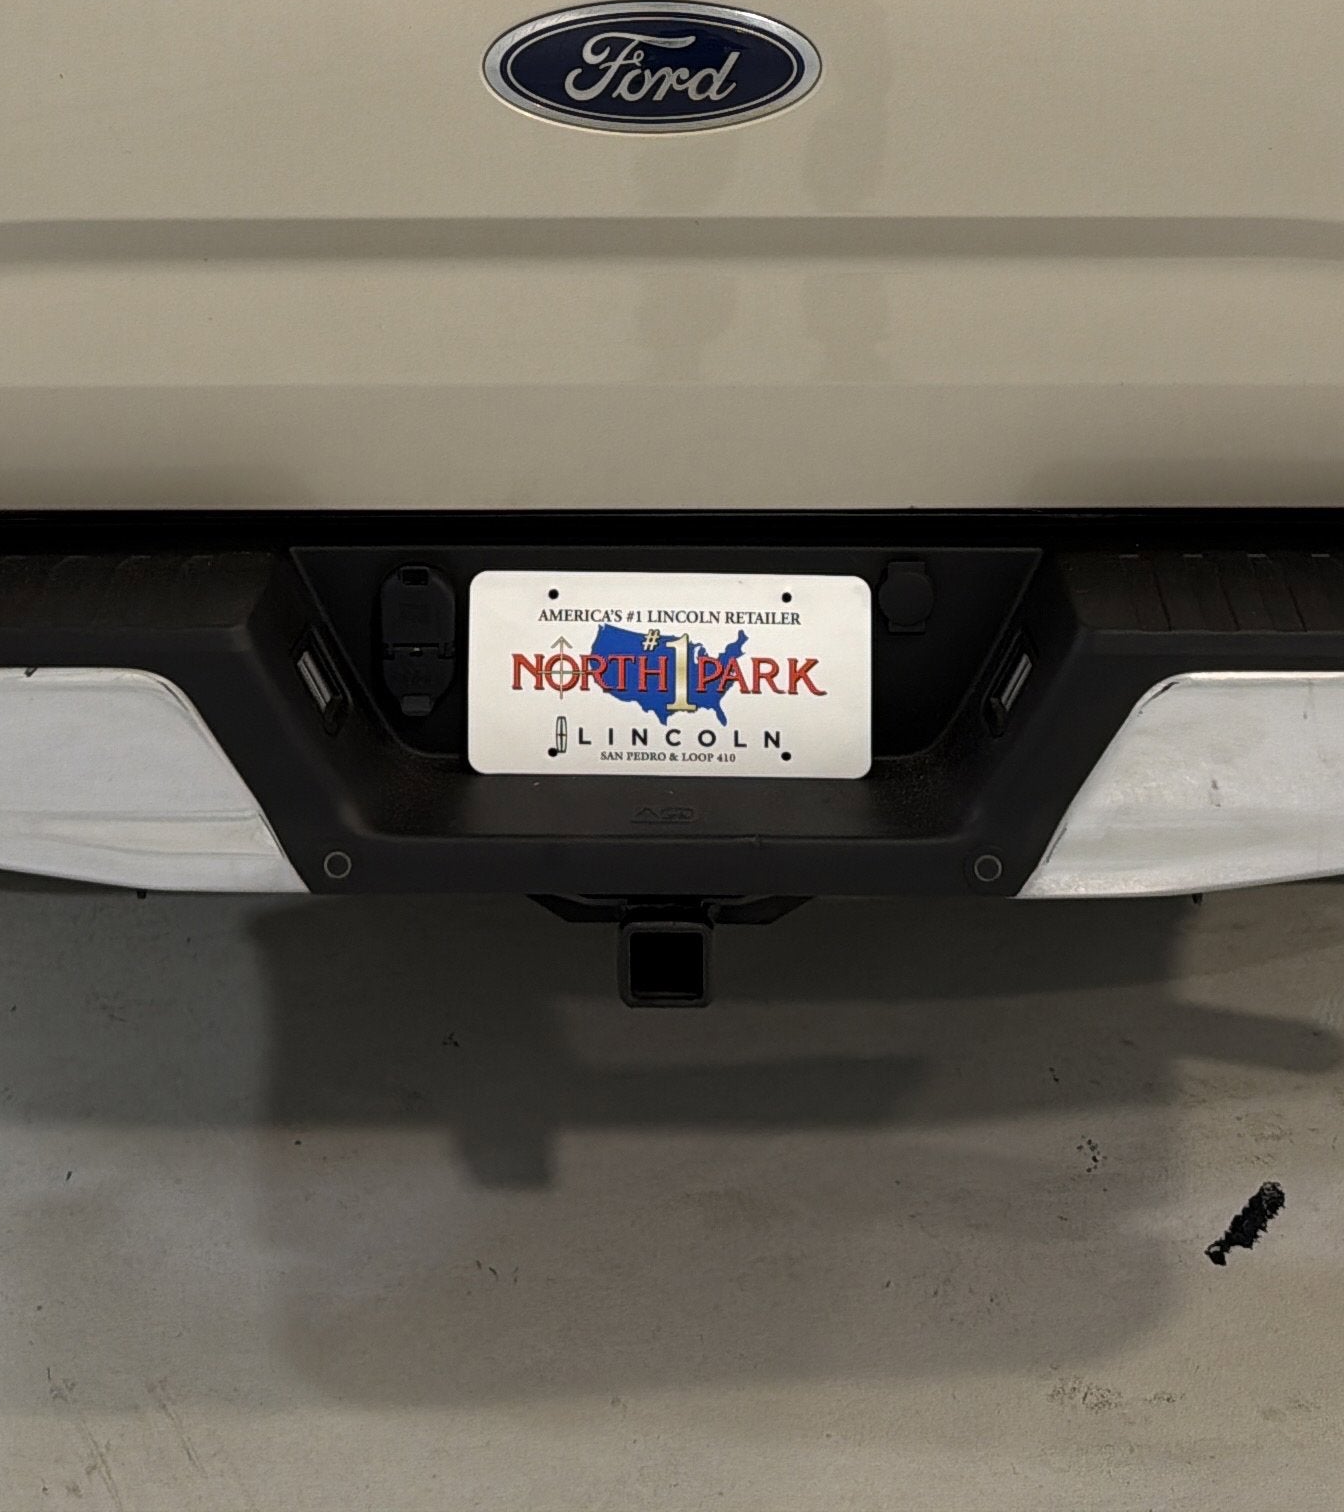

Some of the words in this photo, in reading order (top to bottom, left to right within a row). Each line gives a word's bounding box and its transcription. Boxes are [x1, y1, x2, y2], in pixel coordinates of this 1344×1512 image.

[564, 32, 741, 102] Ford
[538, 609, 622, 623] AMERICA'S
[626, 609, 642, 623] #1
[647, 609, 720, 624] LINCOLN
[725, 610, 802, 626] RETAILER
[511, 653, 670, 693] NORTH
[696, 655, 828, 696] PARK
[578, 727, 782, 749] LINCOLN
[600, 751, 624, 761] SAN
[626, 751, 667, 762] PEDRO
[669, 751, 679, 762] &
[682, 752, 714, 763] LOOP
[717, 752, 736, 763] 410
